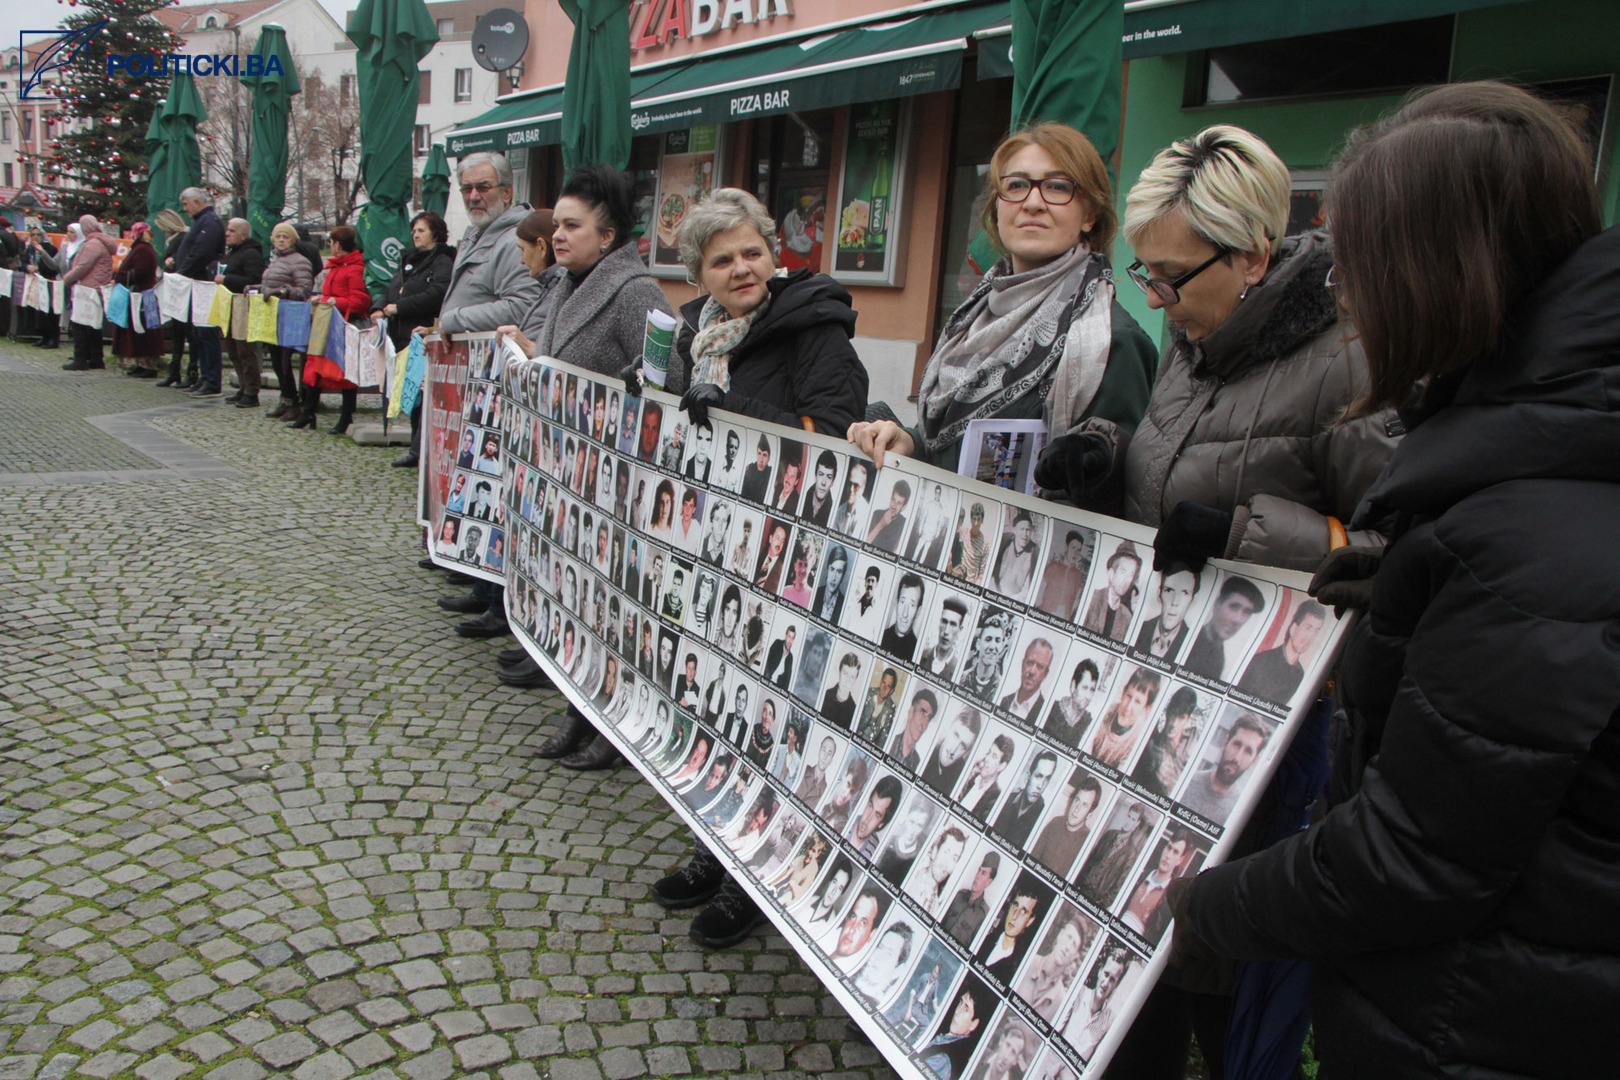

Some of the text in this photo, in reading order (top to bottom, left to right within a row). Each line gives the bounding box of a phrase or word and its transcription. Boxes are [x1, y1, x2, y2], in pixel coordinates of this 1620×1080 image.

[1122, 34, 1133, 42] eer
[1143, 29, 1155, 39] the
[1157, 25, 1182, 37] world.
[730, 89, 790, 115] PIZZA BAR
[507, 130, 525, 145] PIZZA
[525, 128, 540, 143] BAR
[873, 198, 883, 229] PAN
[1228, 686, 1254, 702] Hasanović
[1156, 797, 1171, 809] Mujo
[1208, 824, 1220, 835] Atif
